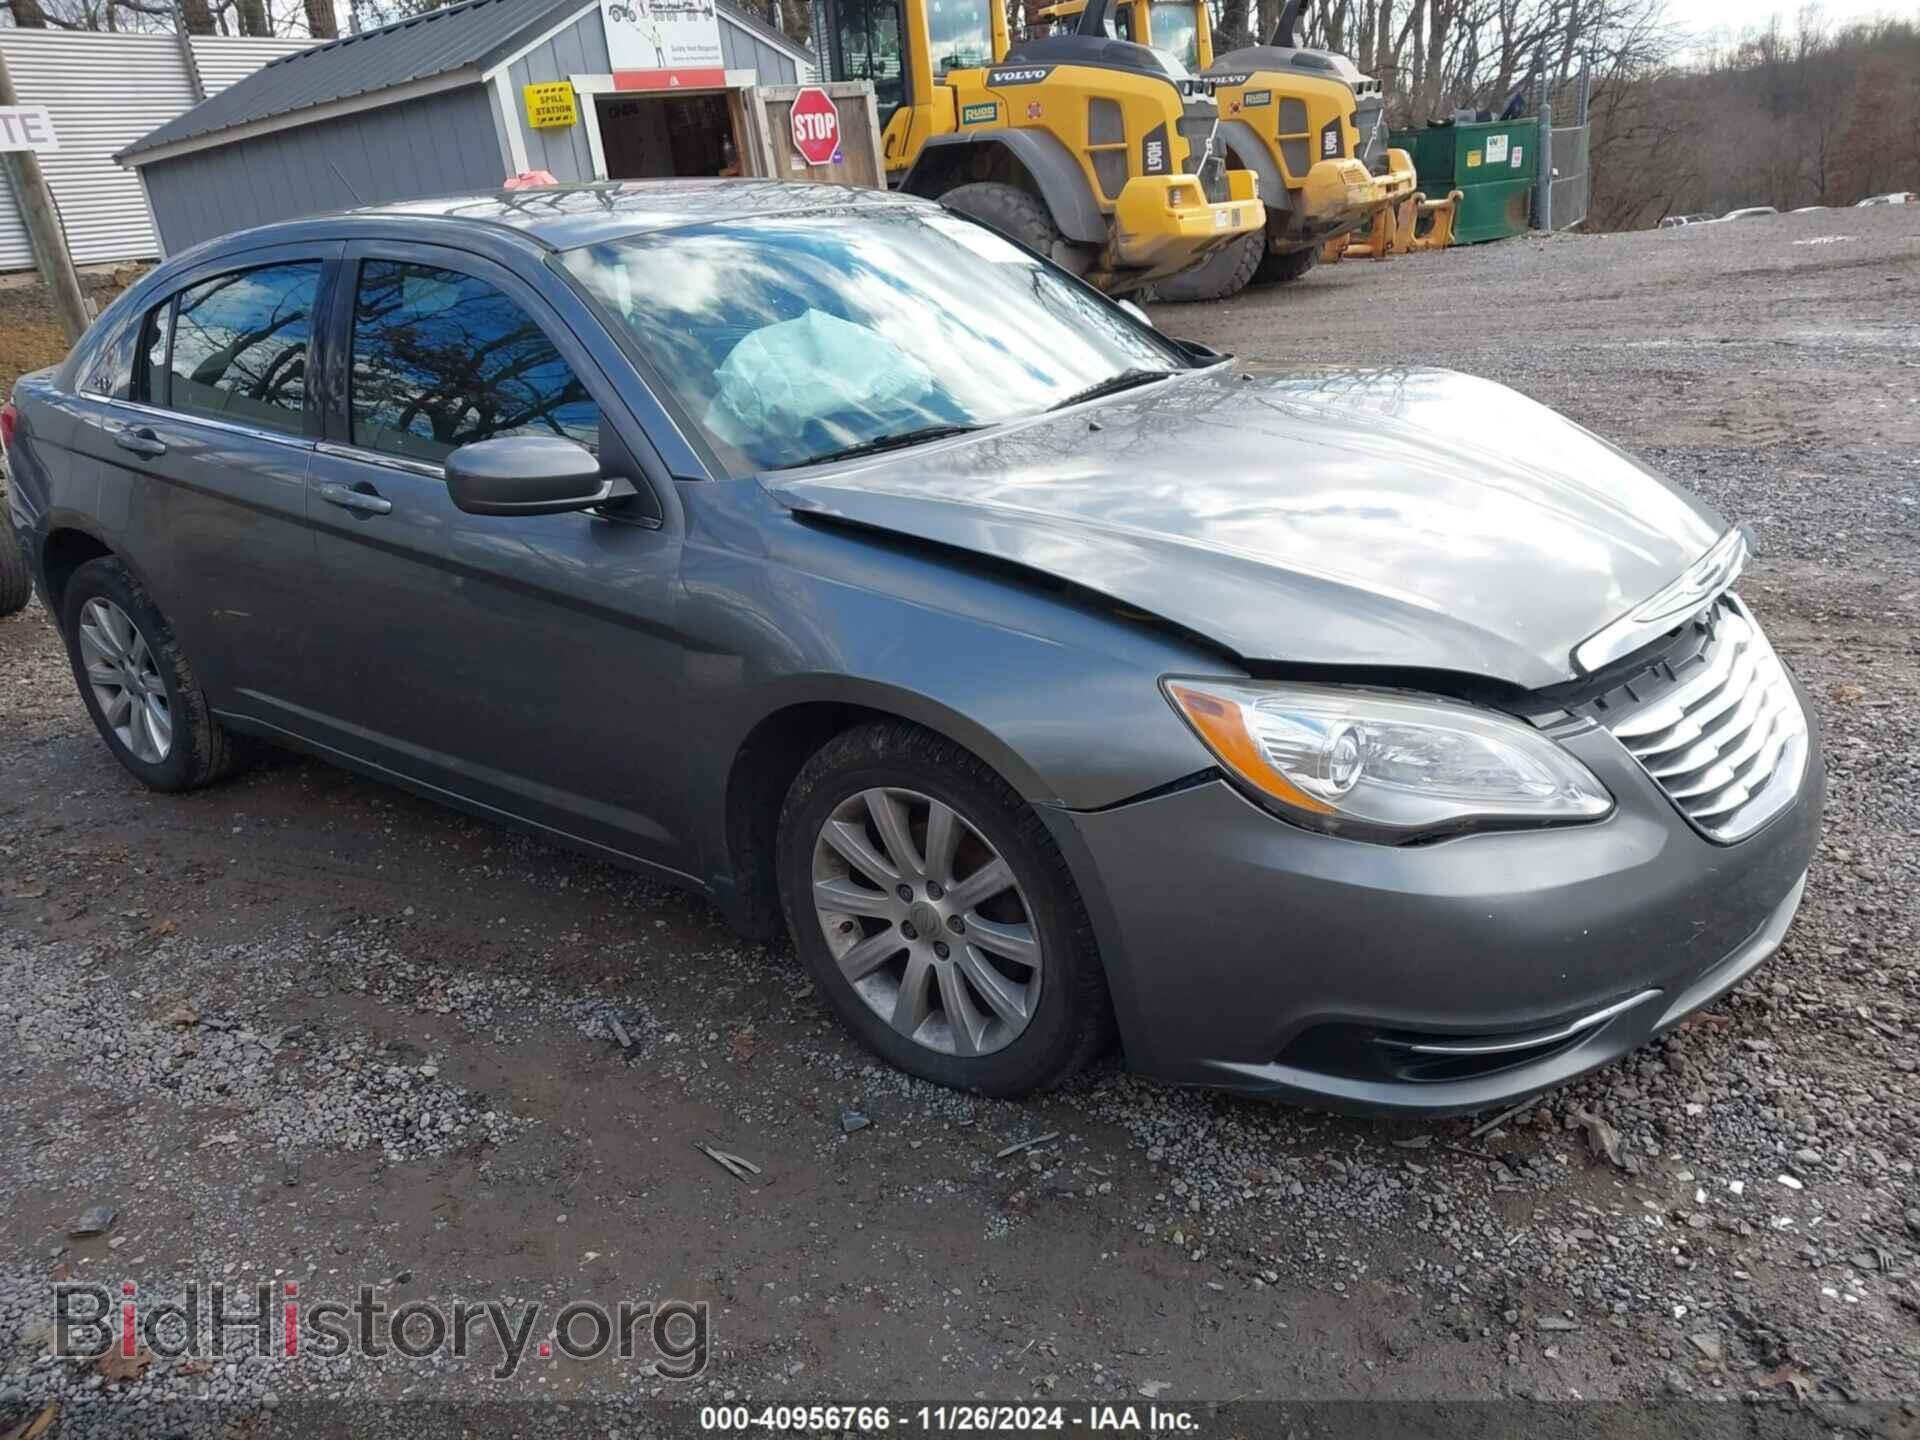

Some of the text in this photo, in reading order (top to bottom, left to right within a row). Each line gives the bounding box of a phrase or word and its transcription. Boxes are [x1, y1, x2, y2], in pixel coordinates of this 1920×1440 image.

[993, 70, 1046, 81] VOLVO
[536, 104, 572, 115] STATION
[540, 95, 563, 104] SPILL
[0, 113, 48, 143] TE
[795, 112, 835, 141] STOP
[1147, 140, 1163, 171] L90H
